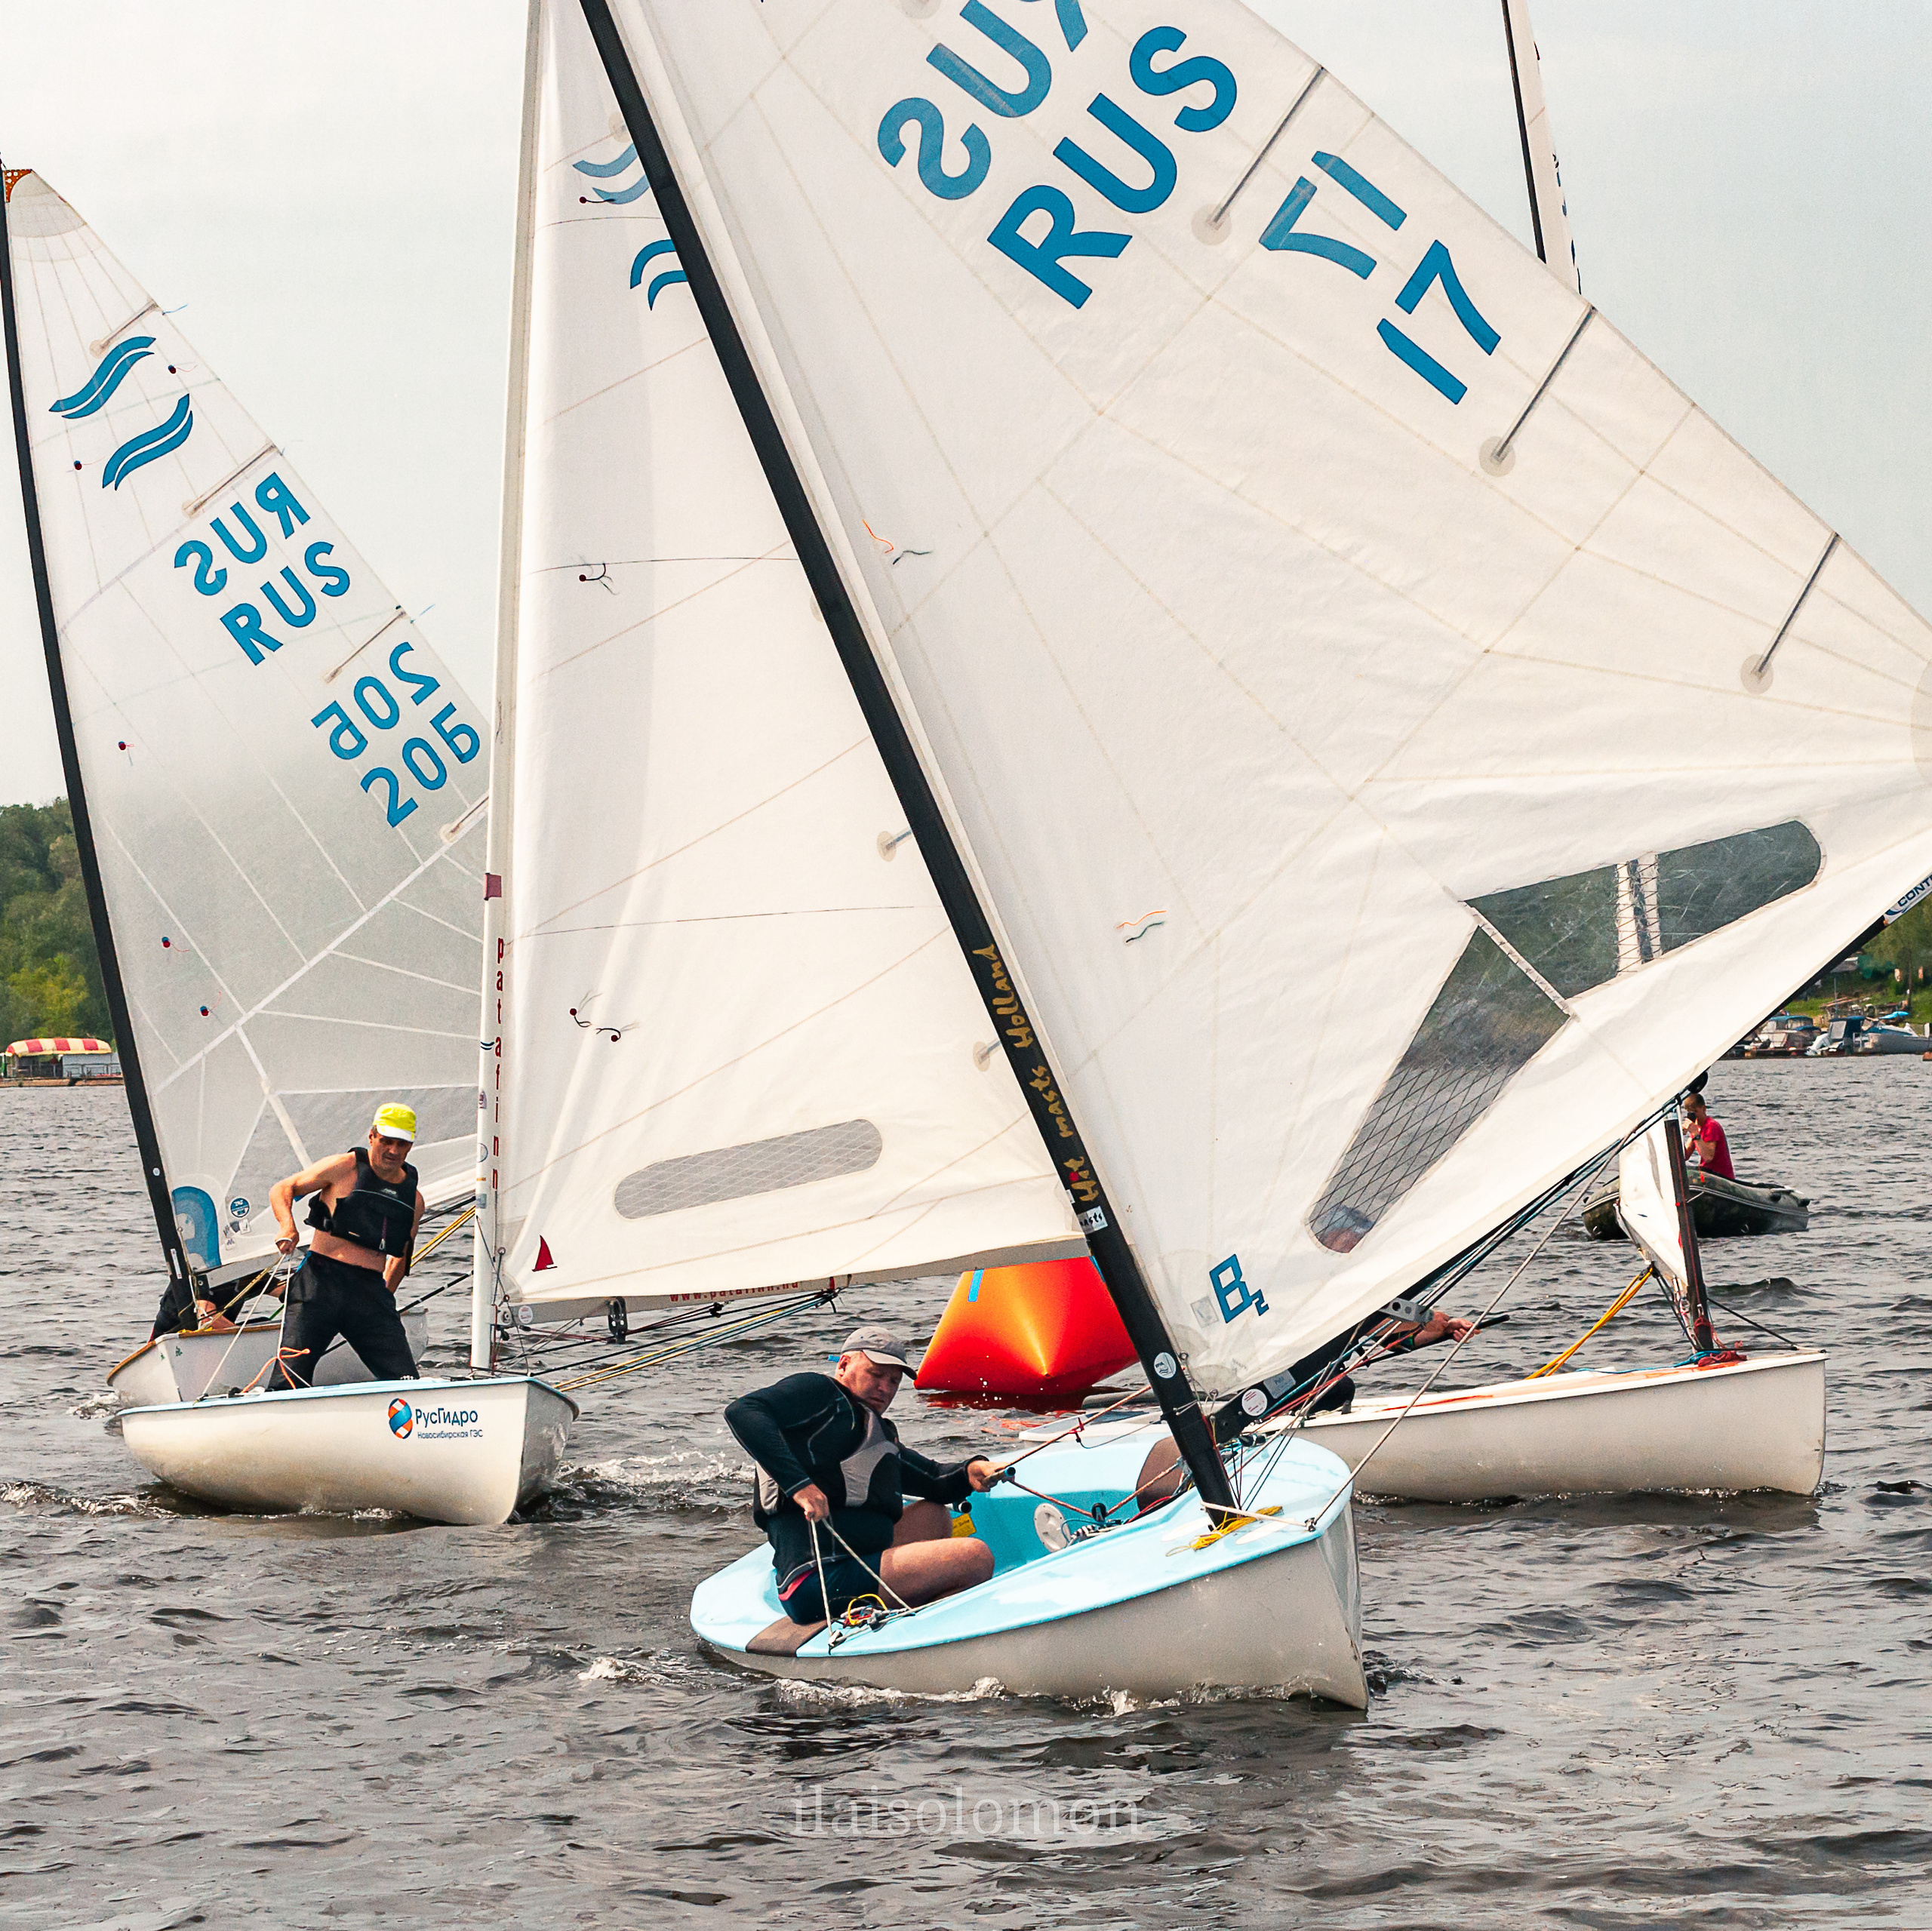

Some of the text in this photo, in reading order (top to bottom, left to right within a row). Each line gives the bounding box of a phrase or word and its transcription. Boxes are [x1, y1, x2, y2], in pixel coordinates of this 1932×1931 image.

[986, 26, 1238, 309] RUS
[1377, 239, 1500, 405] 17
[220, 540, 351, 666] RUS
[972, 943, 1034, 1048] Holland
[1029, 1065, 1074, 1138] masts
[415, 1407, 478, 1428] РусГидро
[417, 1429, 484, 1440] Новосибирская ГЭС
